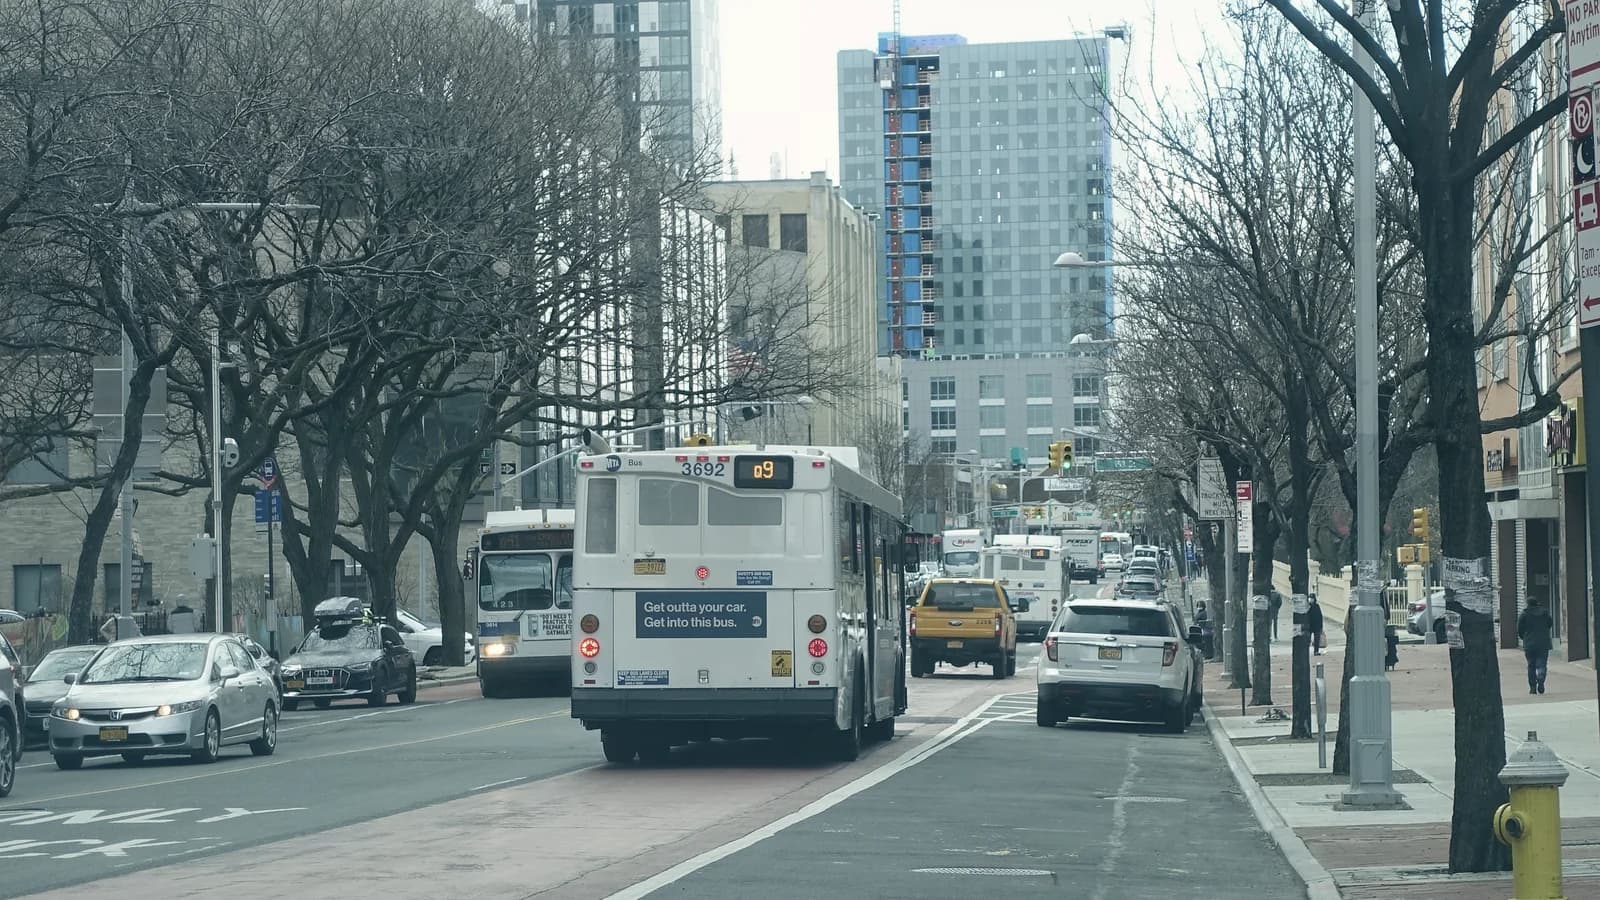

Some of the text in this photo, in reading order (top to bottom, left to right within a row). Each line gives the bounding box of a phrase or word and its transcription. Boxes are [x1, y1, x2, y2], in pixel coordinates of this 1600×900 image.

[1569, 0, 1600, 24] NO PAR
[1570, 22, 1600, 46] Anytim
[1580, 247, 1594, 261] 7am
[628, 458, 643, 466] Bus
[682, 462, 725, 477] 3692
[644, 602, 747, 614] Get outta your car.
[644, 616, 737, 627] Get into this bus.
[0, 838, 187, 858] CK
